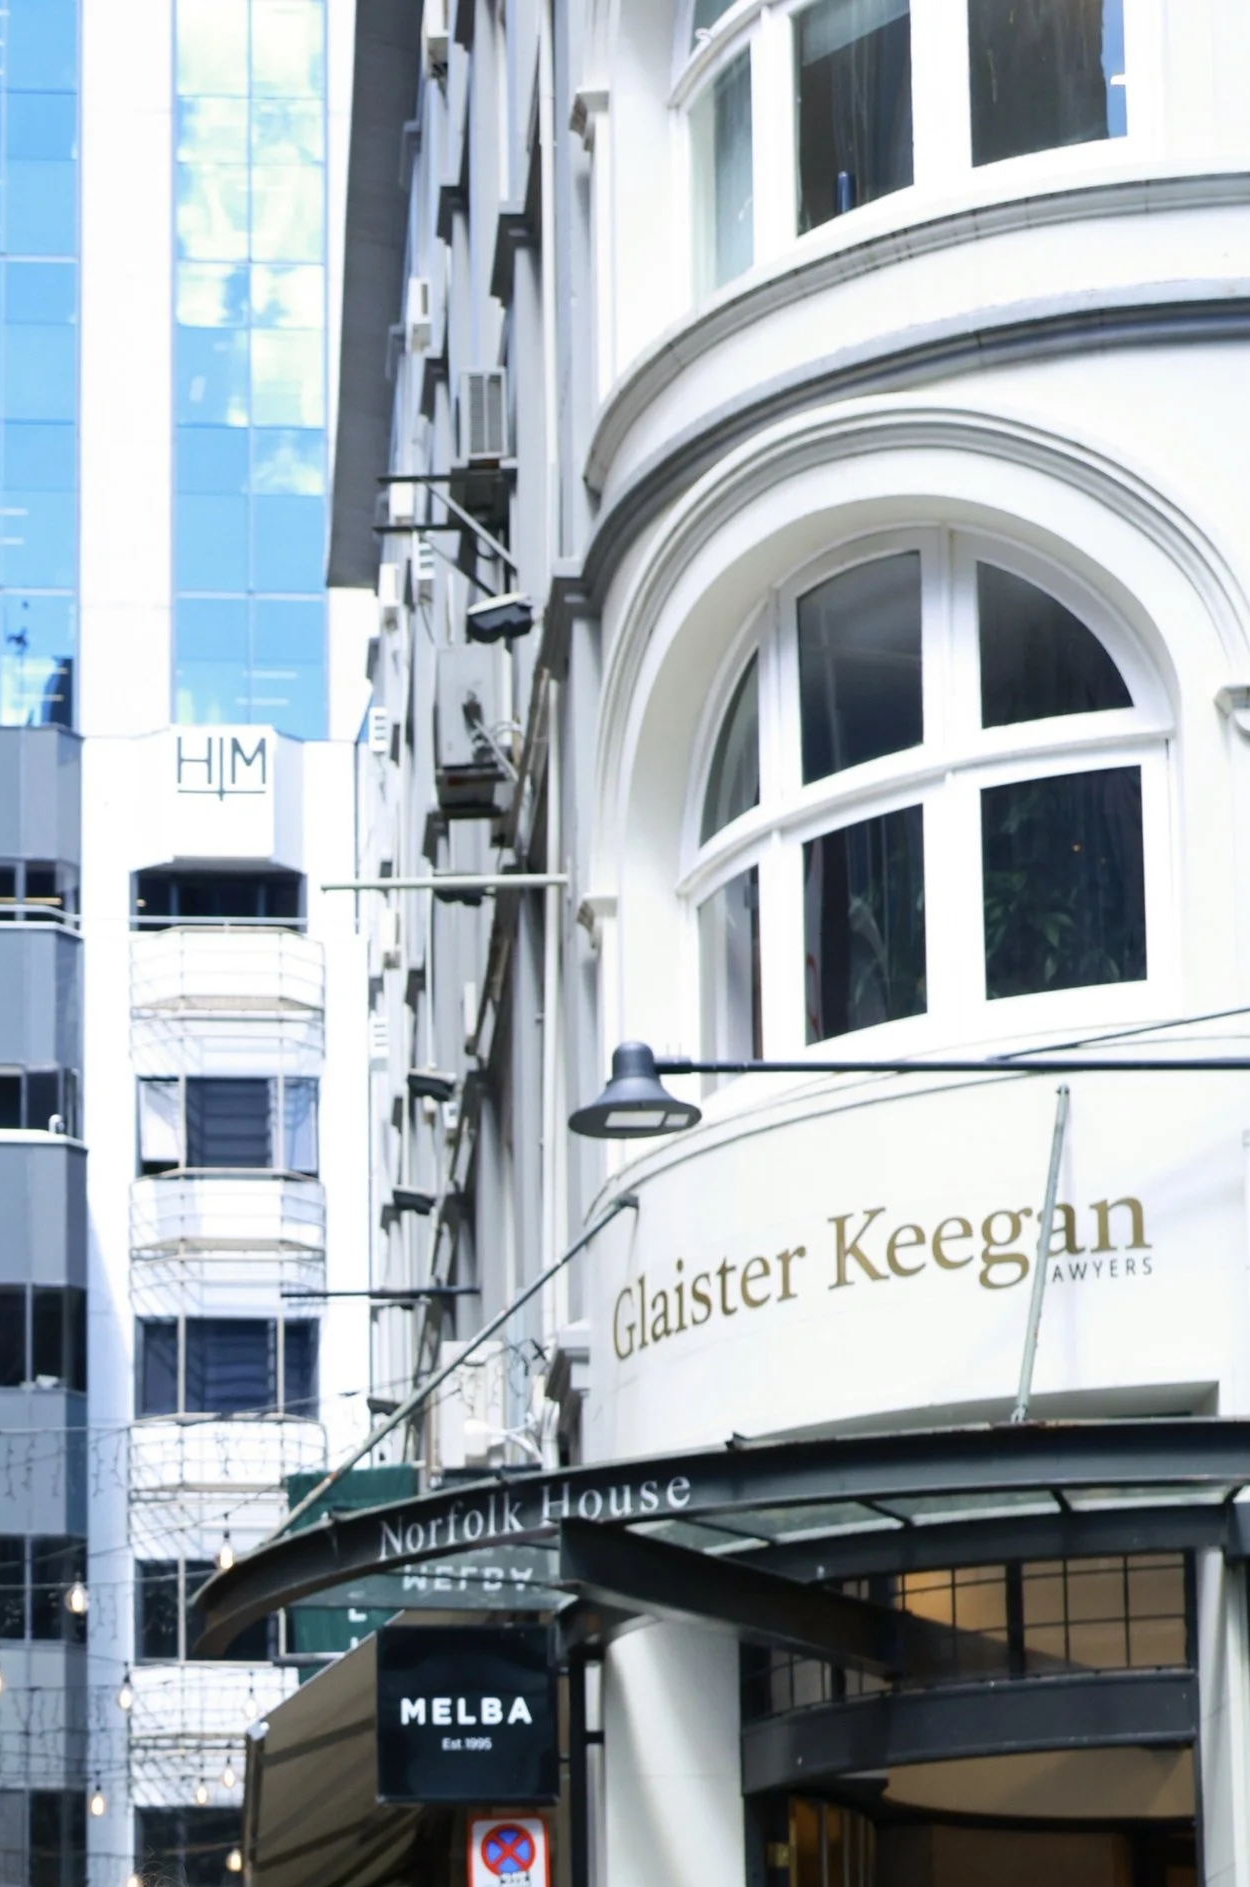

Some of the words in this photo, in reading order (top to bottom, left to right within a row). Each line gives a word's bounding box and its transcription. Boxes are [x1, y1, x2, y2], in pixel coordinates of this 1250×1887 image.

[612, 1245, 807, 1361] Glaister
[827, 1195, 1153, 1289] Keegan
[1052, 1256, 1153, 1283] AWYERS
[379, 1491, 526, 1562] Norfolk
[540, 1475, 692, 1528] House
[400, 1696, 533, 1725] MELBA
